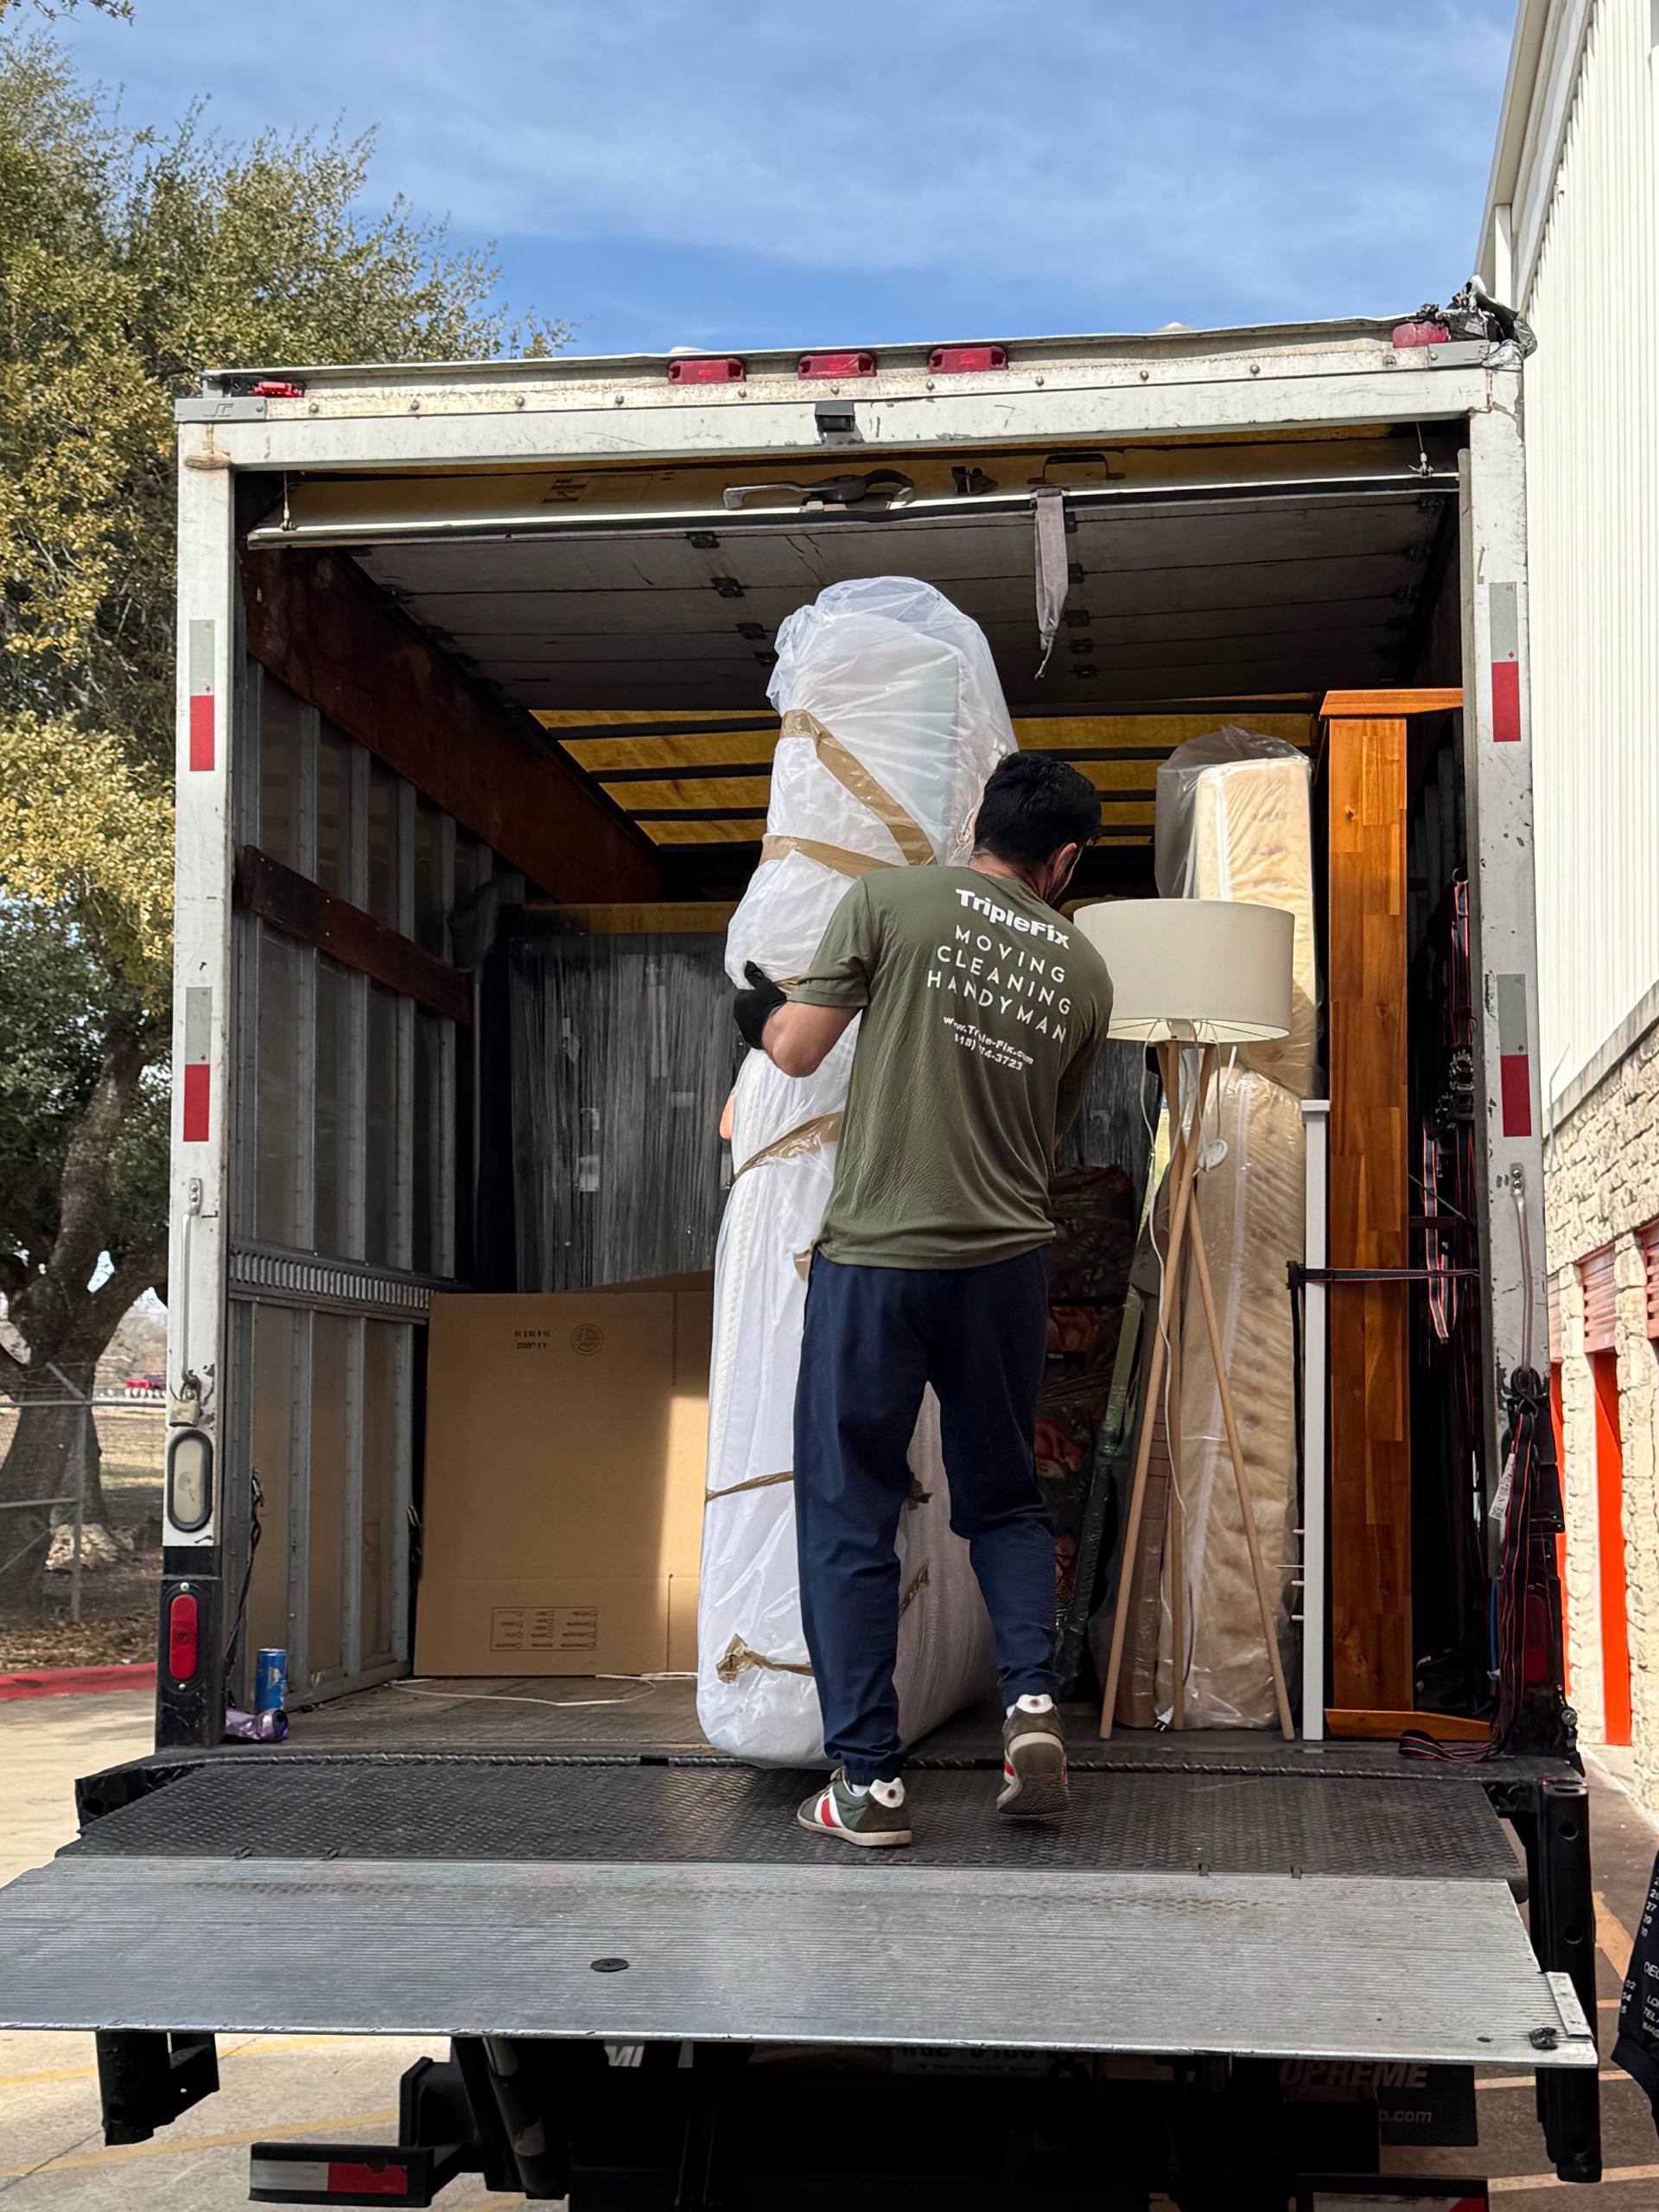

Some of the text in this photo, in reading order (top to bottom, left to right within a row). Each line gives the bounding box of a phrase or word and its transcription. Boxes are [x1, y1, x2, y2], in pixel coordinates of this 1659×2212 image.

[956, 888, 1070, 950] TripleFix
[937, 945, 1071, 1015] CLEANING
[955, 925, 1065, 983] MOVING
[927, 969, 1067, 1044] HANDYMAN
